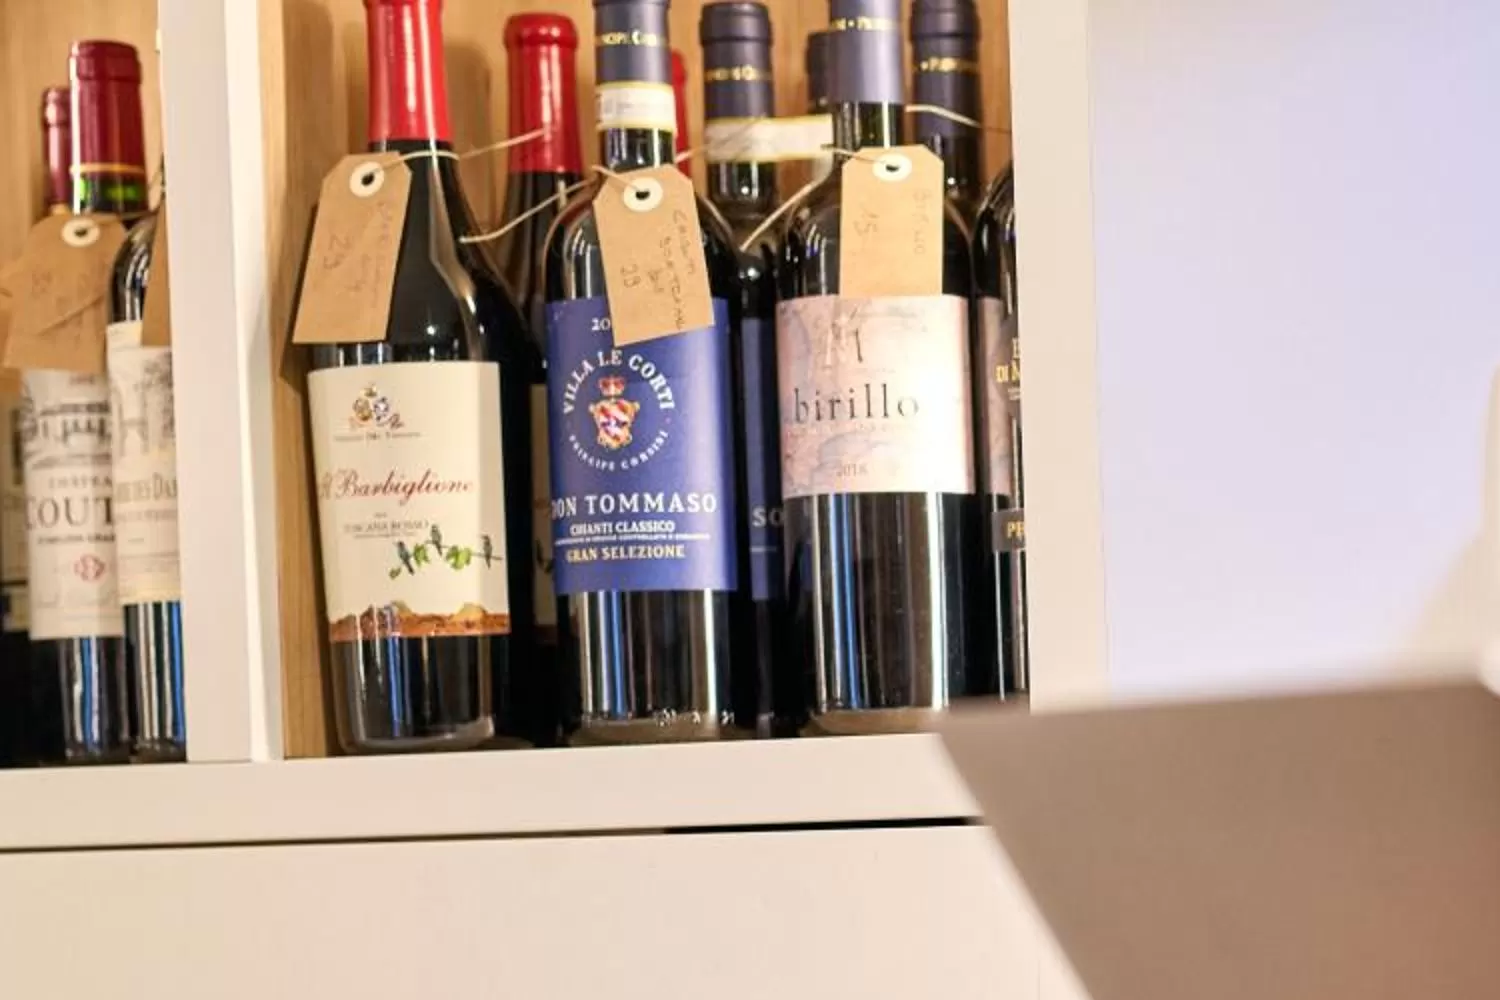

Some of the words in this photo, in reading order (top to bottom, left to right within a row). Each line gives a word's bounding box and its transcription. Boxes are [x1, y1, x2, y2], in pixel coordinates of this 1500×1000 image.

[562, 359, 595, 415] VILLA
[597, 349, 624, 367] LE
[628, 354, 676, 411] CORTI
[794, 383, 920, 425] birillo
[333, 467, 474, 507] Barbiglione
[583, 491, 718, 515] TOMMASO
[569, 522, 614, 537] CHIANTI
[615, 520, 676, 533] CLASSICO
[566, 547, 598, 564] GRAN
[601, 543, 686, 560] SELEZIONE
